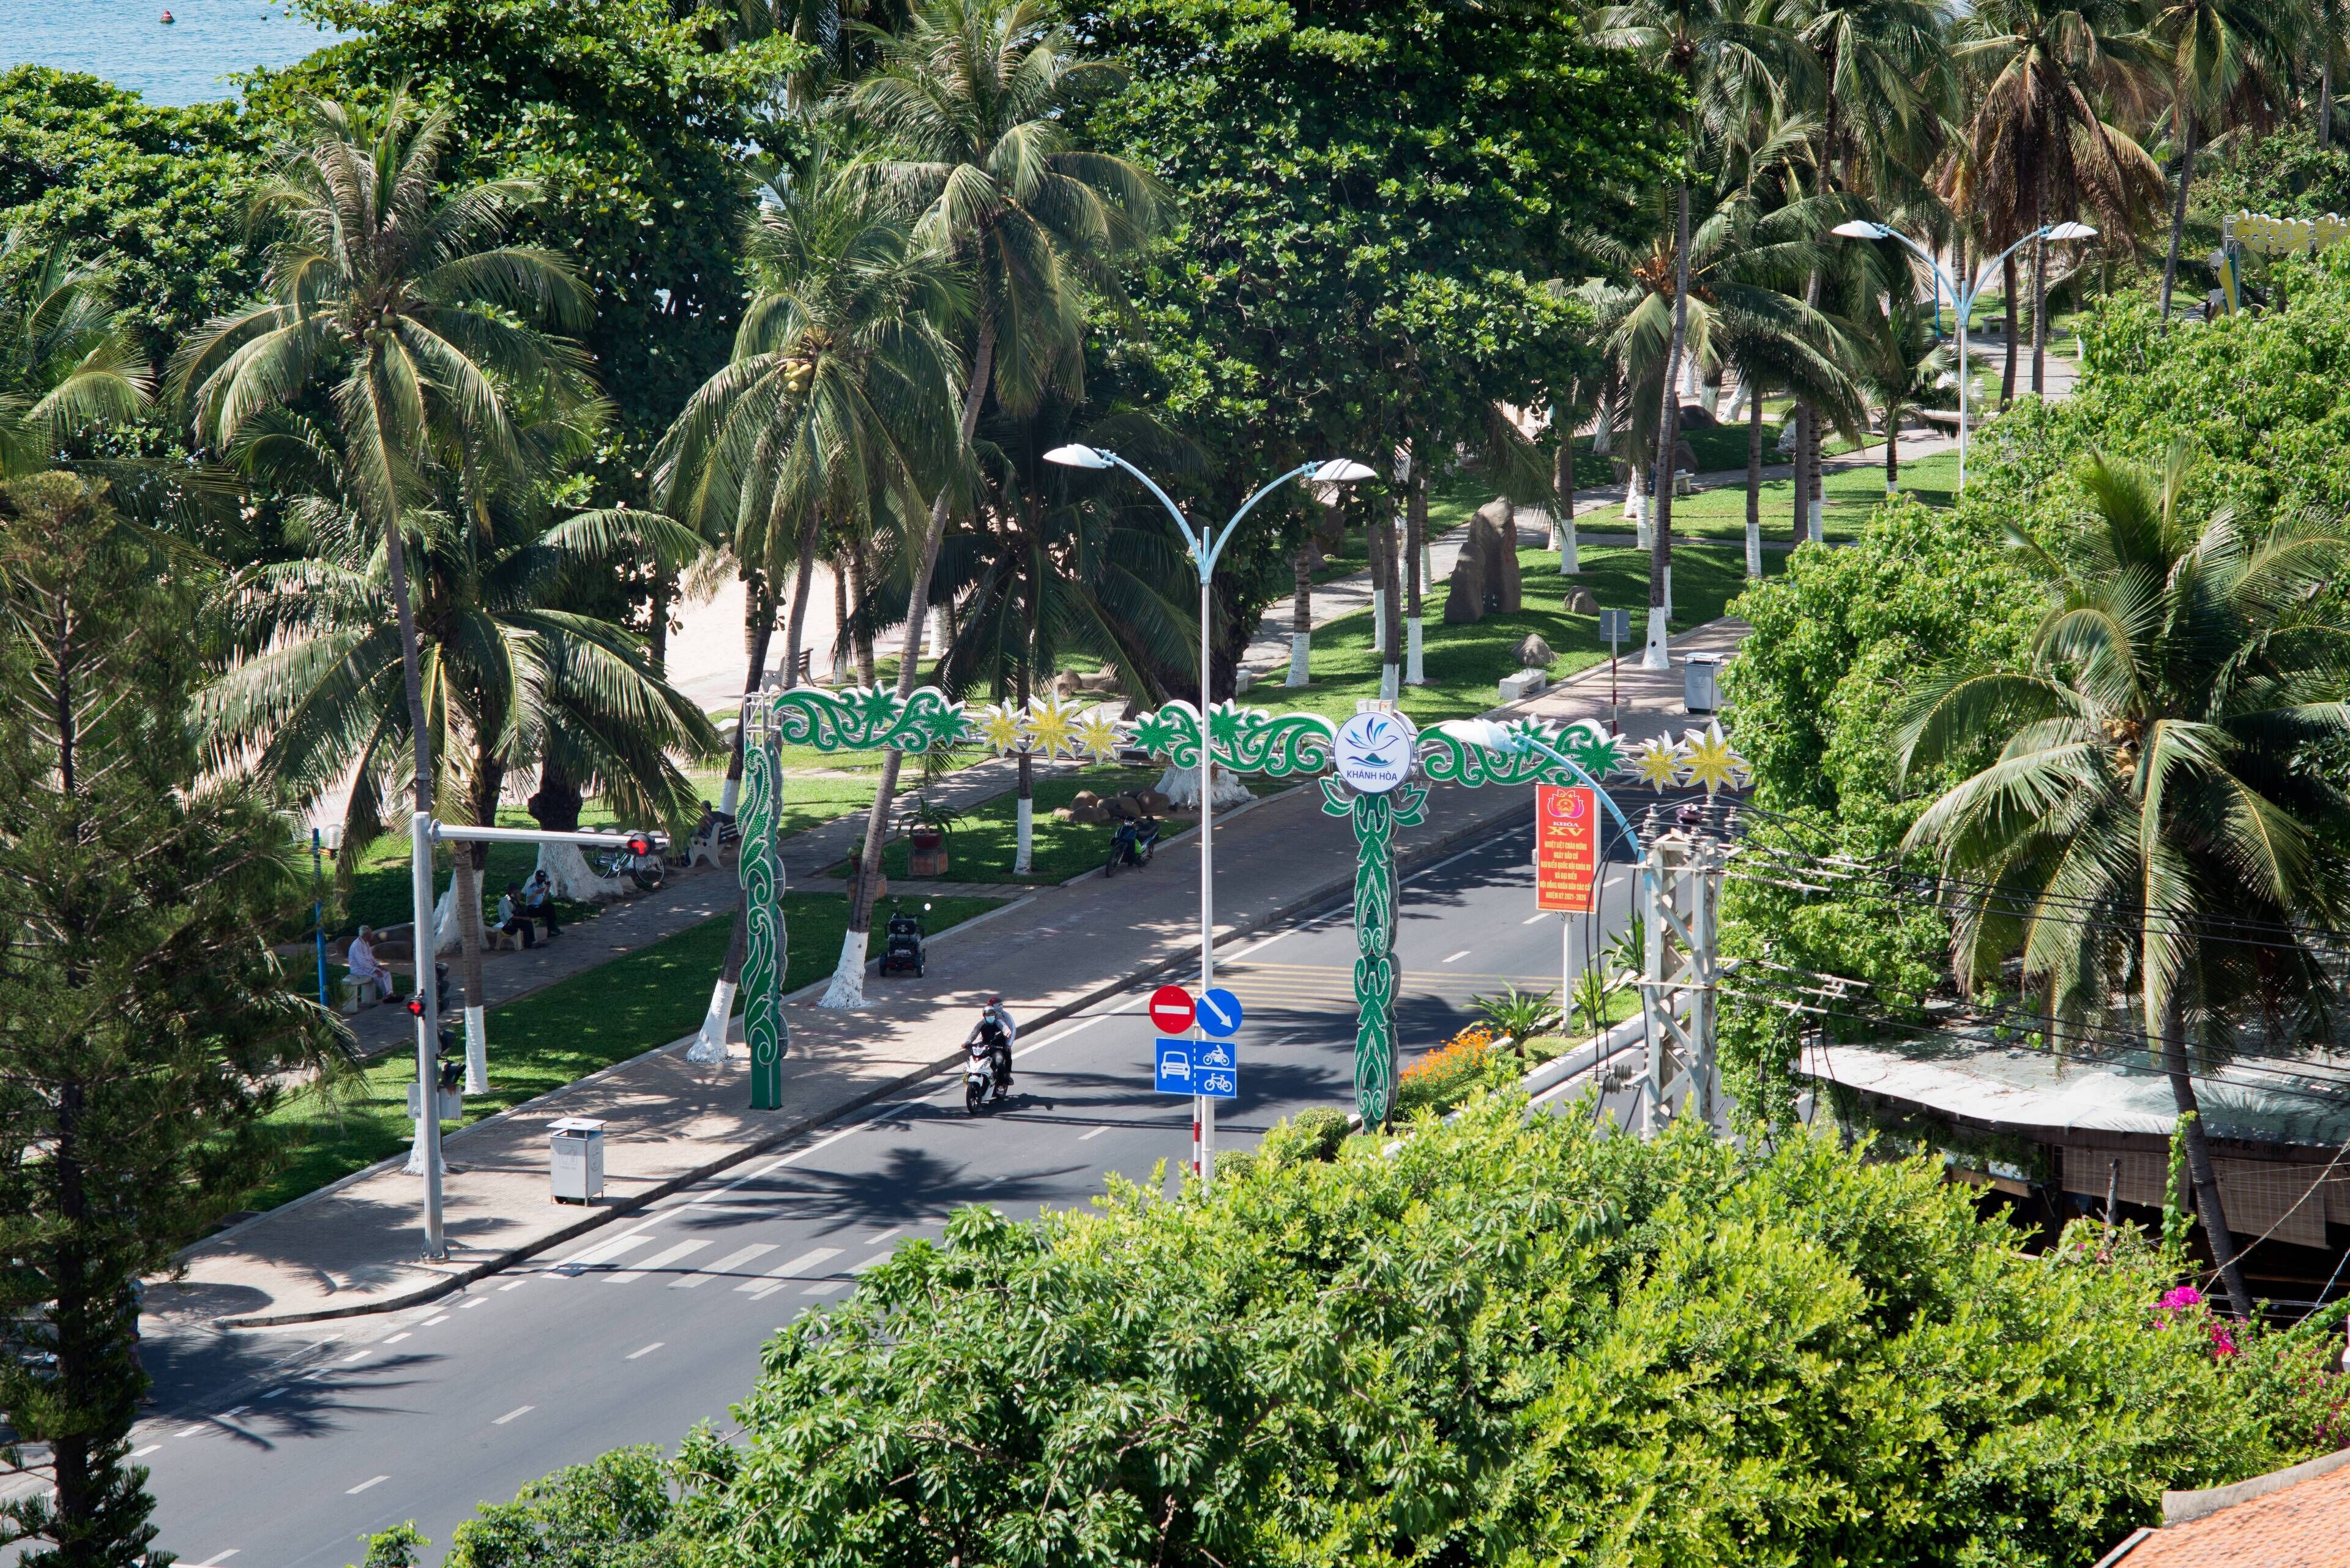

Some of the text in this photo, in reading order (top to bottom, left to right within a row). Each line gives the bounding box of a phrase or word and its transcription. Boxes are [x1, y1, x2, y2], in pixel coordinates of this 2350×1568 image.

[1346, 769, 1398, 782] KHÁNH HÒA
[1547, 826, 1586, 837] XV
